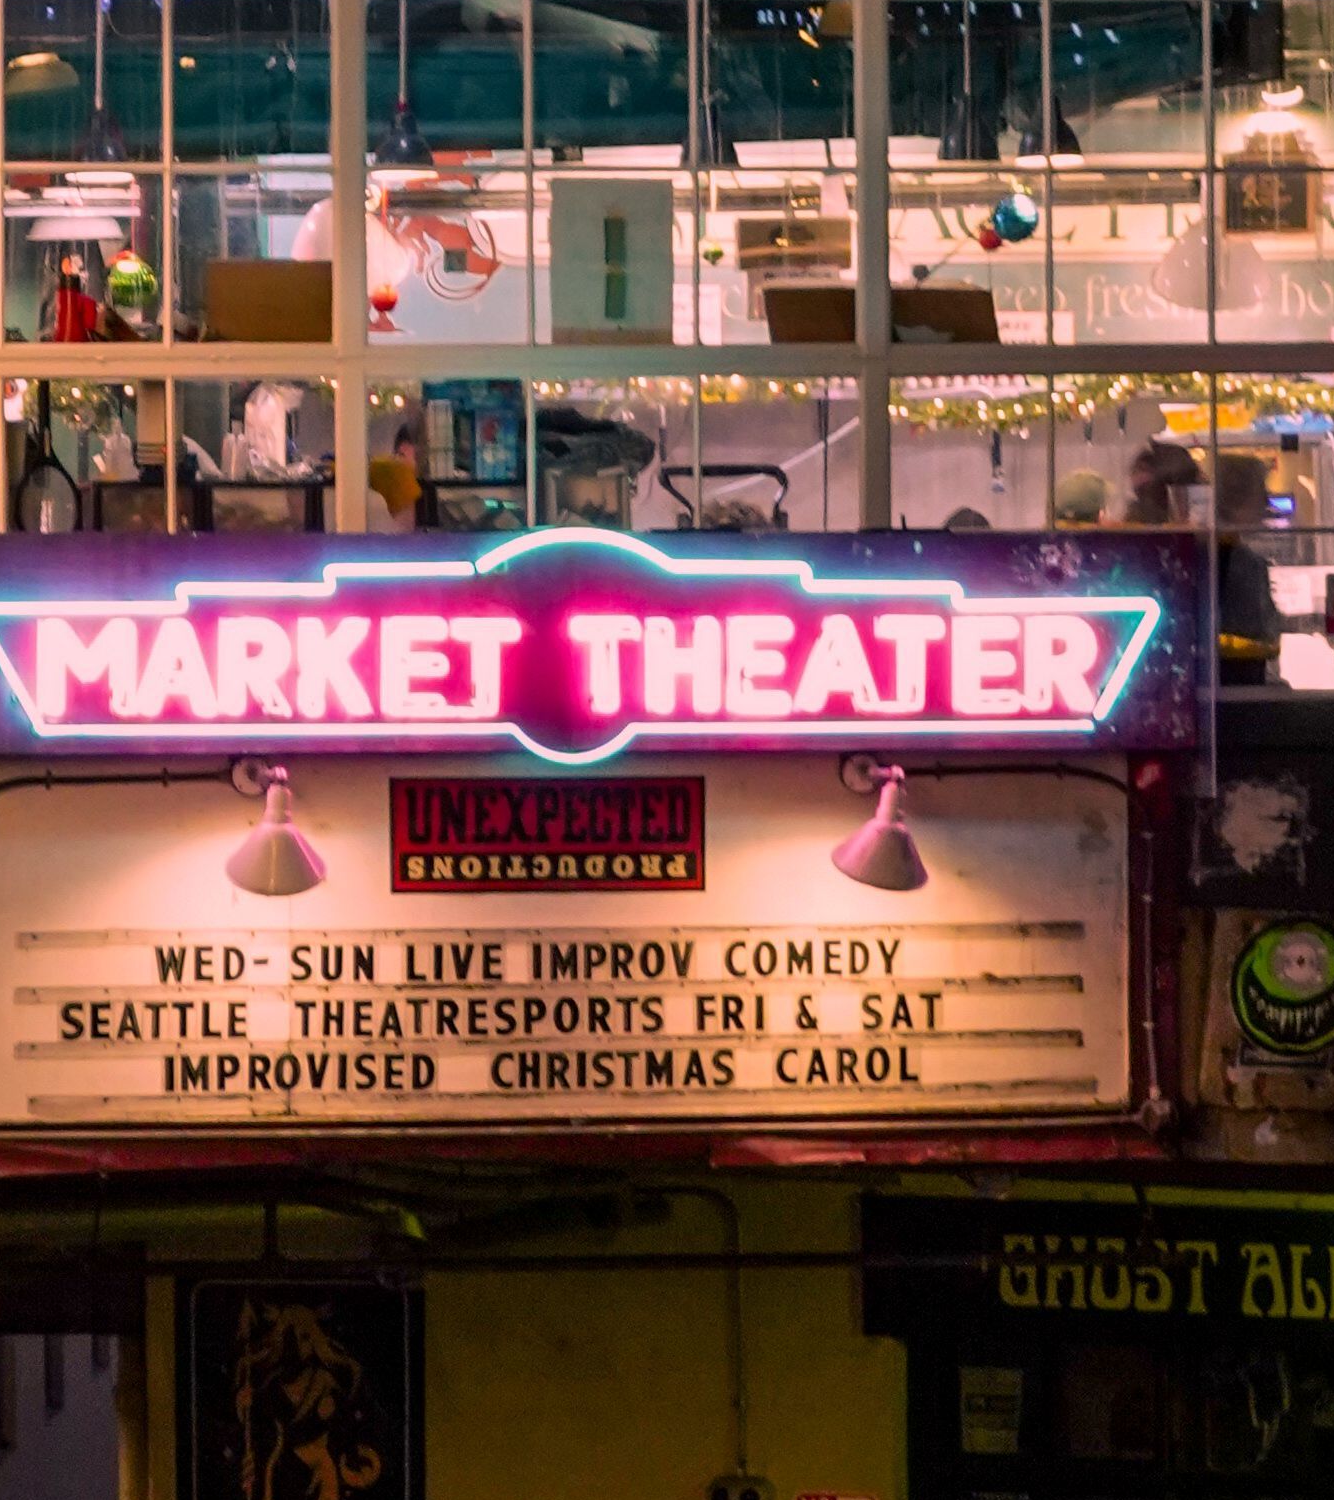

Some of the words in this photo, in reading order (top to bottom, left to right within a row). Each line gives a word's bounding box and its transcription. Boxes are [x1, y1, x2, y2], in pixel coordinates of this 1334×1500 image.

[29, 614, 522, 721] MARKET
[565, 612, 1105, 718] THEATER
[405, 784, 692, 844] UNEXPECTED
[407, 852, 688, 881] PRODUCTIONS
[290, 943, 375, 981] SUN
[405, 942, 503, 980] LIVE
[531, 940, 695, 980] IMPROV
[724, 938, 900, 976] COMEDY
[60, 1000, 248, 1040] SEATTLE
[294, 996, 664, 1036] THEATRESPORTS
[695, 994, 765, 1032] FRI
[795, 993, 818, 1030] &
[862, 992, 942, 1030] SAT
[164, 1053, 435, 1092] IMPROVISED
[490, 1048, 735, 1089] CHRISTMAS
[775, 1046, 920, 1083] CAROL
